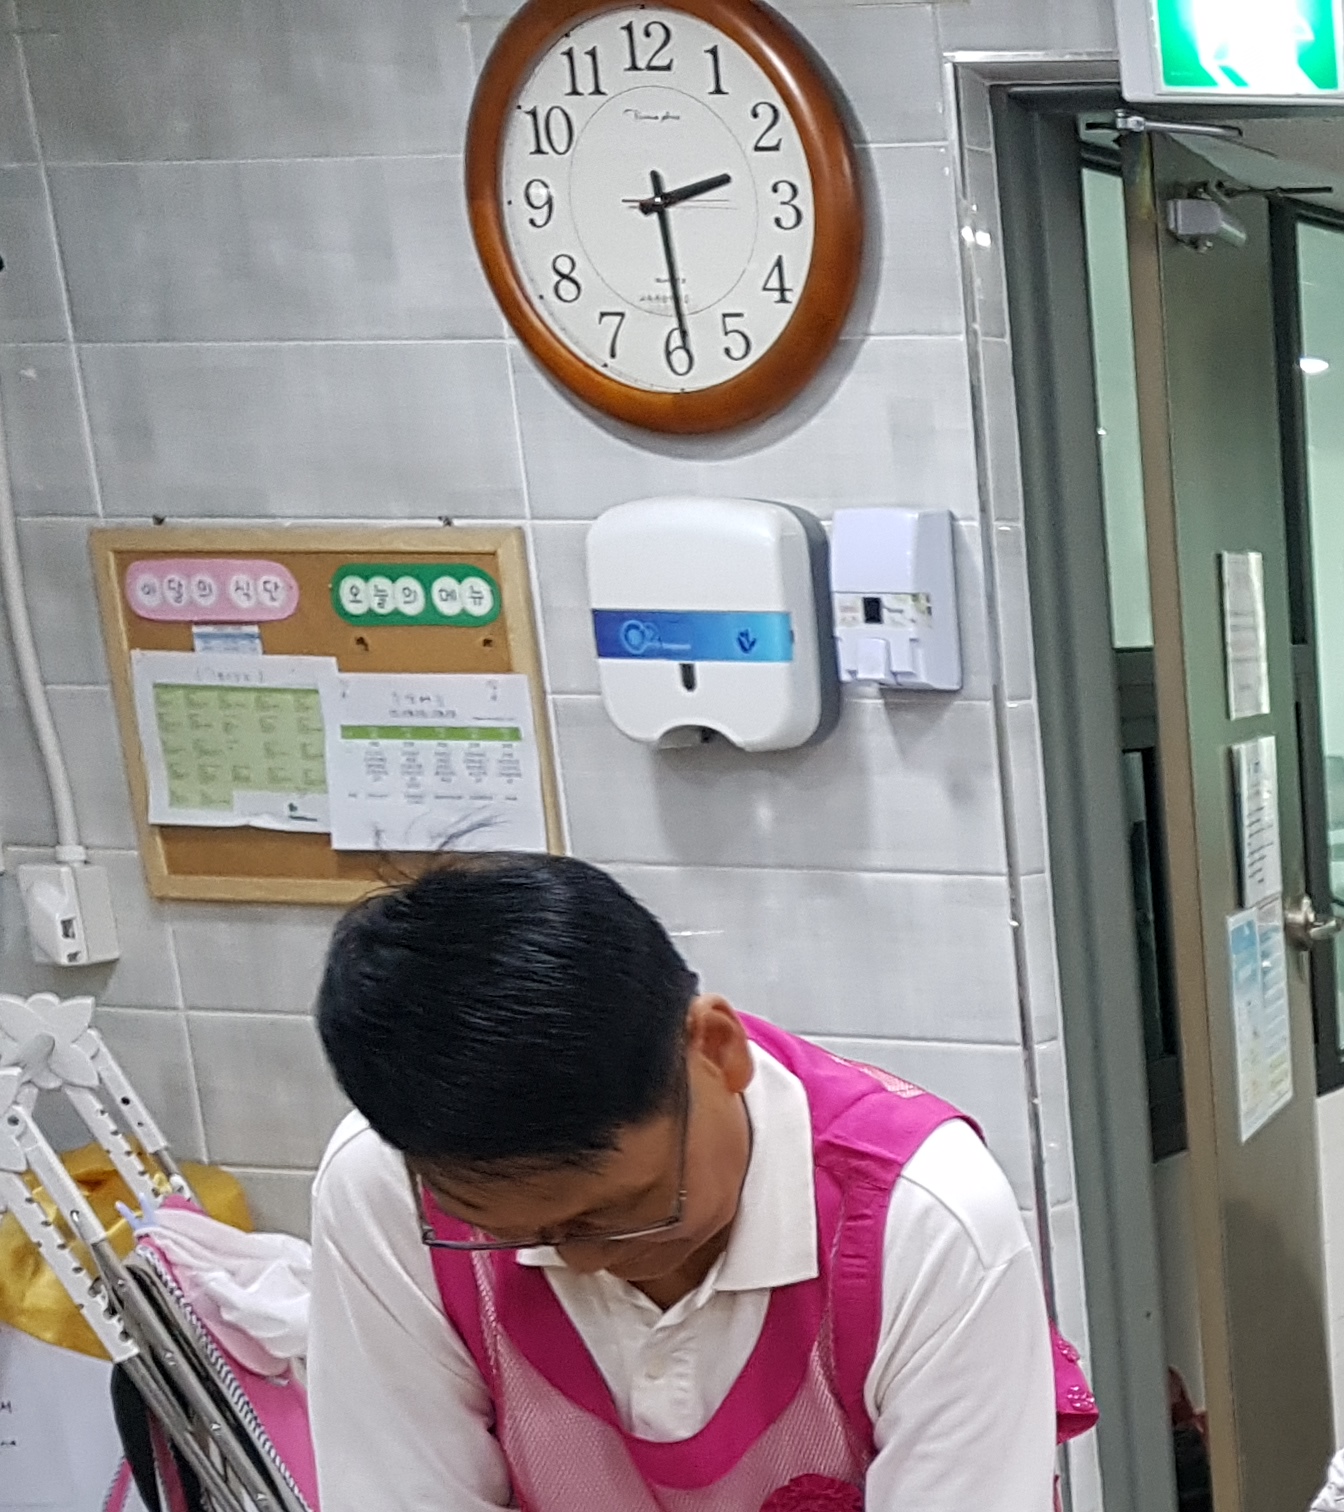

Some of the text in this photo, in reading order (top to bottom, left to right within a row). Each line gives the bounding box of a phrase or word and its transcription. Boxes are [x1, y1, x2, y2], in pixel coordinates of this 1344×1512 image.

[620, 20, 674, 71] 12
[704, 45, 729, 95] 1
[561, 45, 607, 96] 11
[525, 106, 574, 155] 10
[751, 102, 782, 151] 2
[524, 179, 554, 228] 9
[771, 180, 802, 230] 3
[552, 254, 582, 303] 8
[762, 255, 792, 304] 4
[599, 312, 625, 359] 7
[665, 328, 694, 376] 6
[722, 313, 752, 360] 5
[141, 578, 280, 604] 이달의 식단
[349, 584, 485, 609] 오늘의 메뉴
